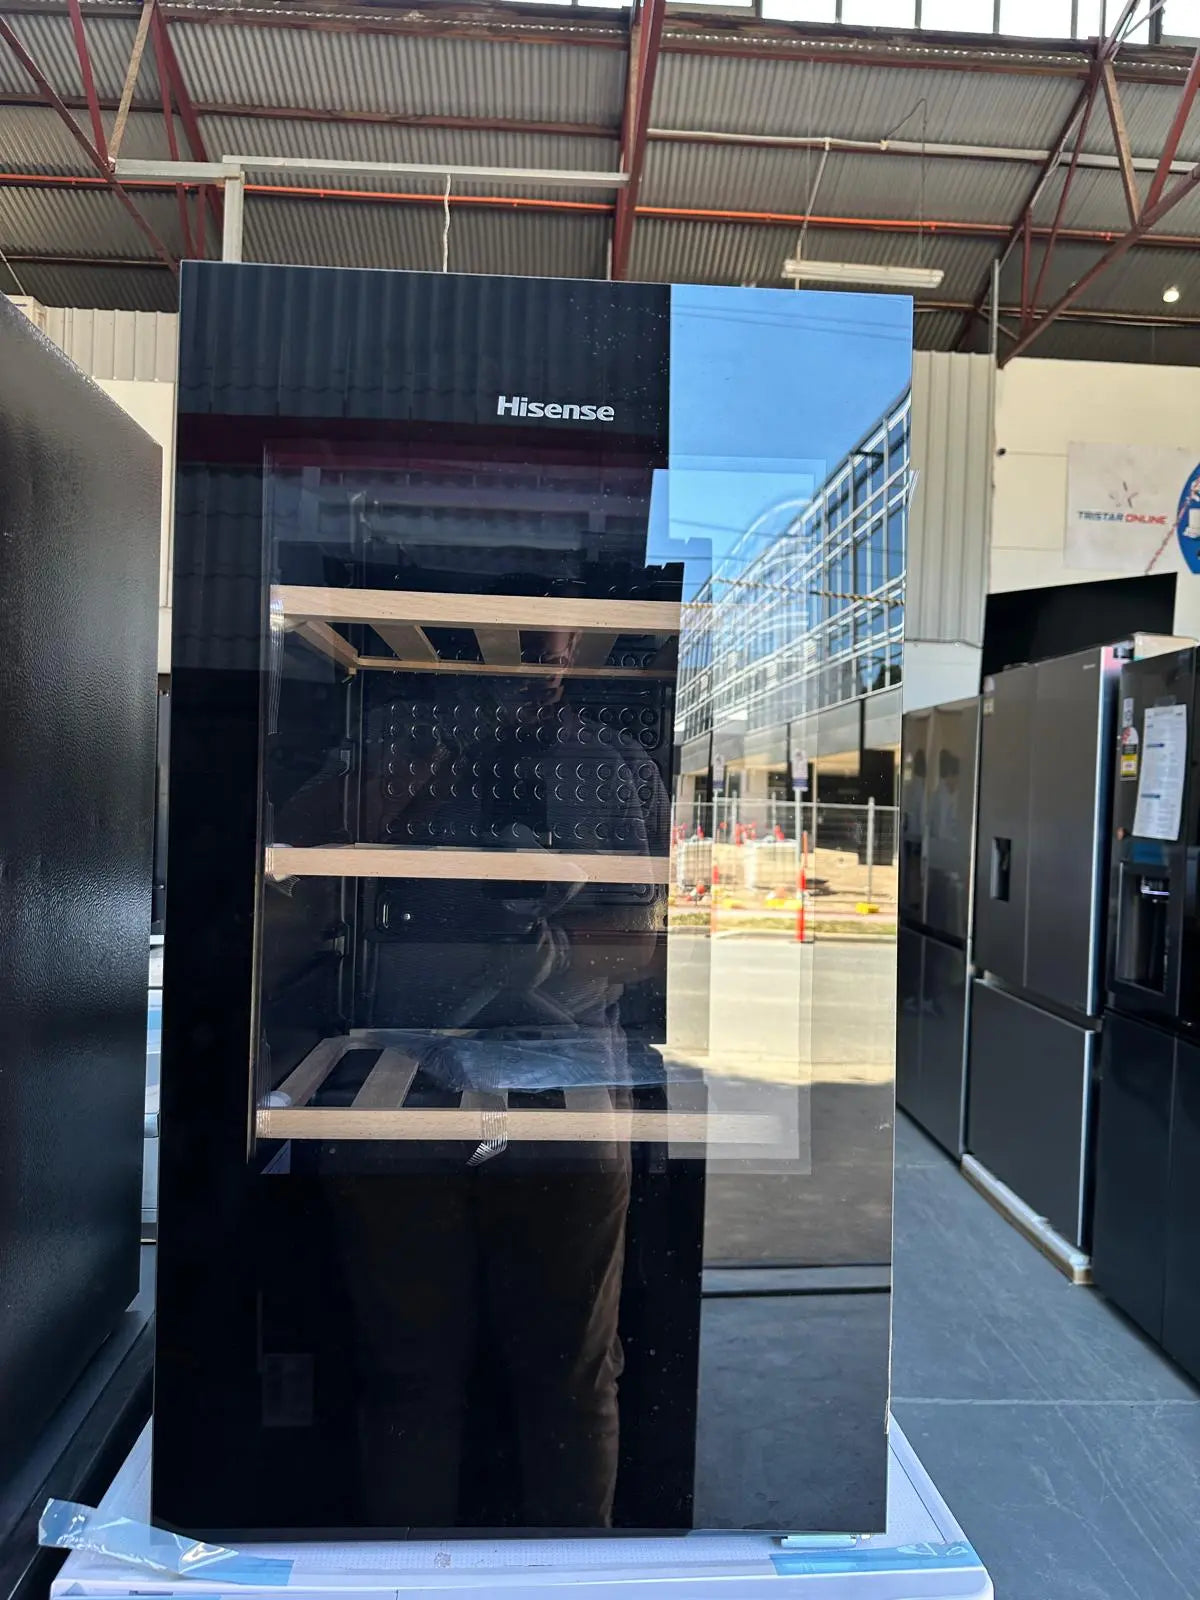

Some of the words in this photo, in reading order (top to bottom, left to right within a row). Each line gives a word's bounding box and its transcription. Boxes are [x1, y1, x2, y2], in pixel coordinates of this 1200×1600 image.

[496, 395, 615, 421] Hisense
[1078, 511, 1124, 522] TRISTAR
[1125, 513, 1168, 525] ONLINE
